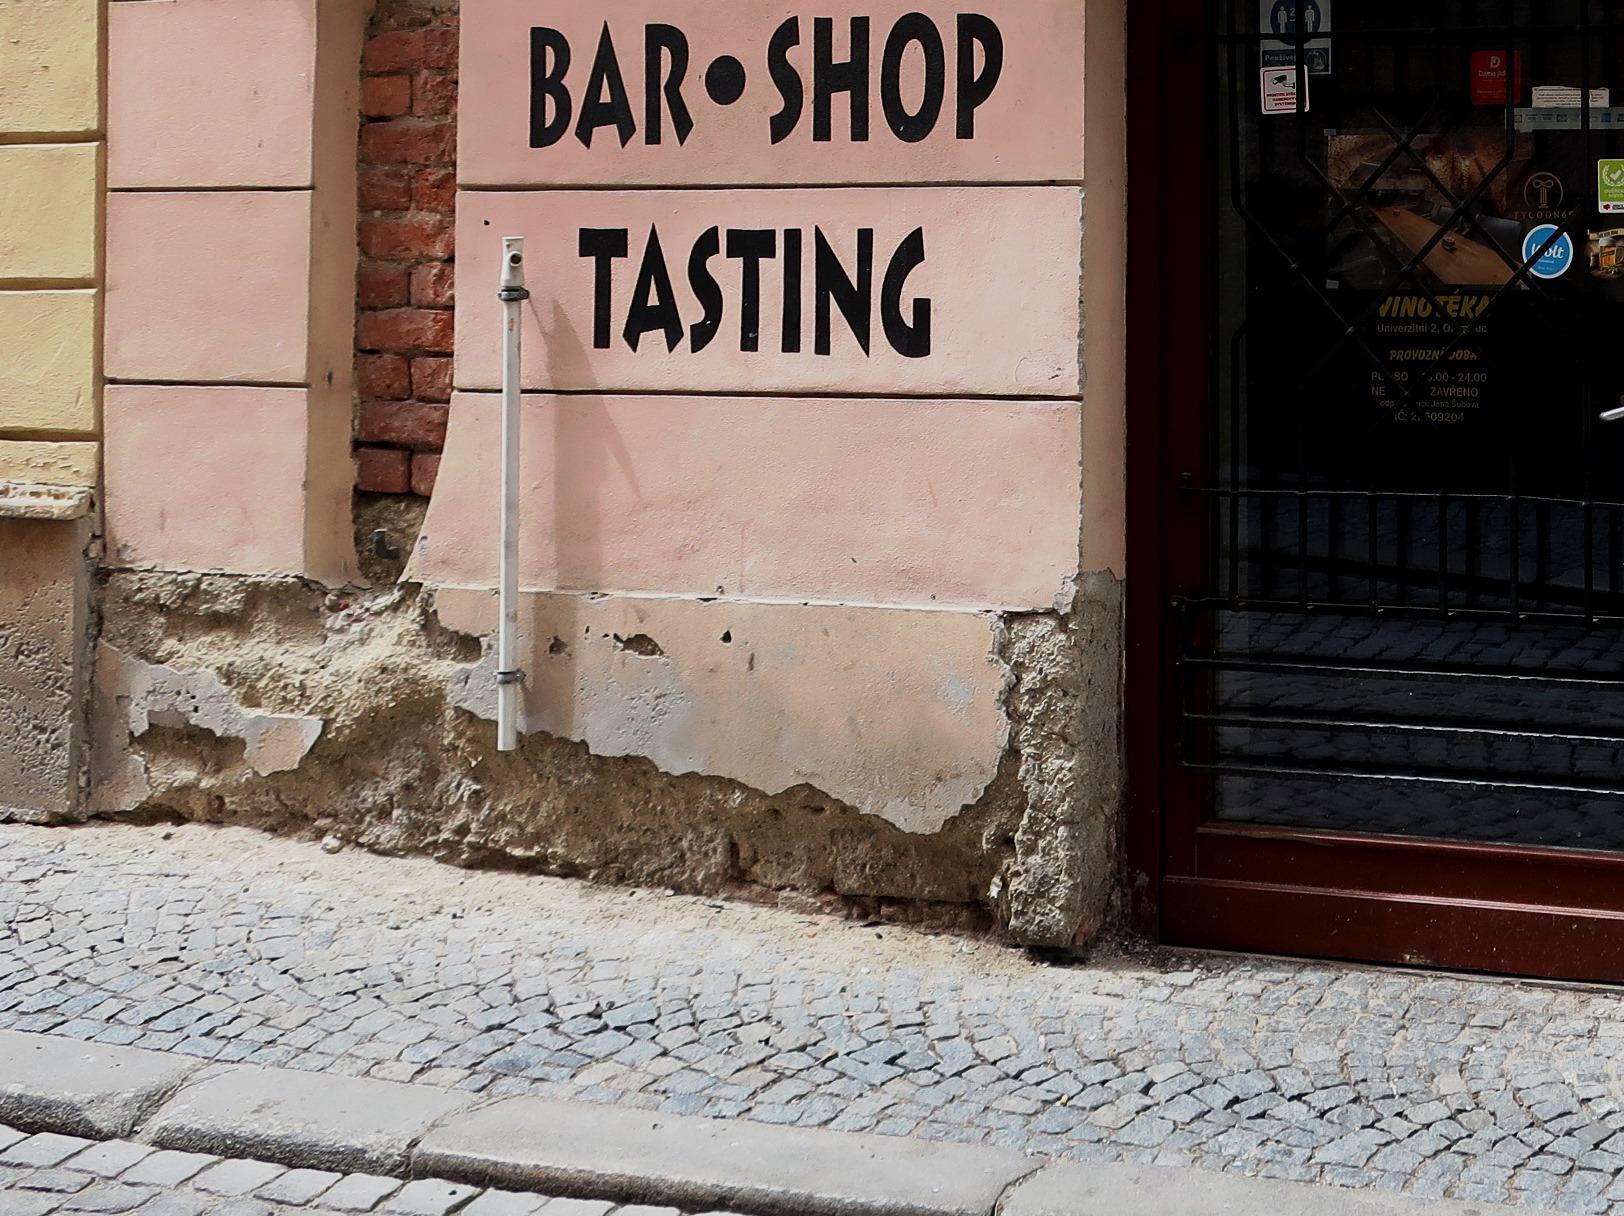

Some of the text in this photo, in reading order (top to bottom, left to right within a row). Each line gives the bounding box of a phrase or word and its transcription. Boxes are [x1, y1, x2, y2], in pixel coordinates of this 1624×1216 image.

[529, 11, 1004, 149] BAR SHOP
[578, 223, 931, 359] TASTING
[1370, 384, 1479, 397] NE ZAVŘENO
